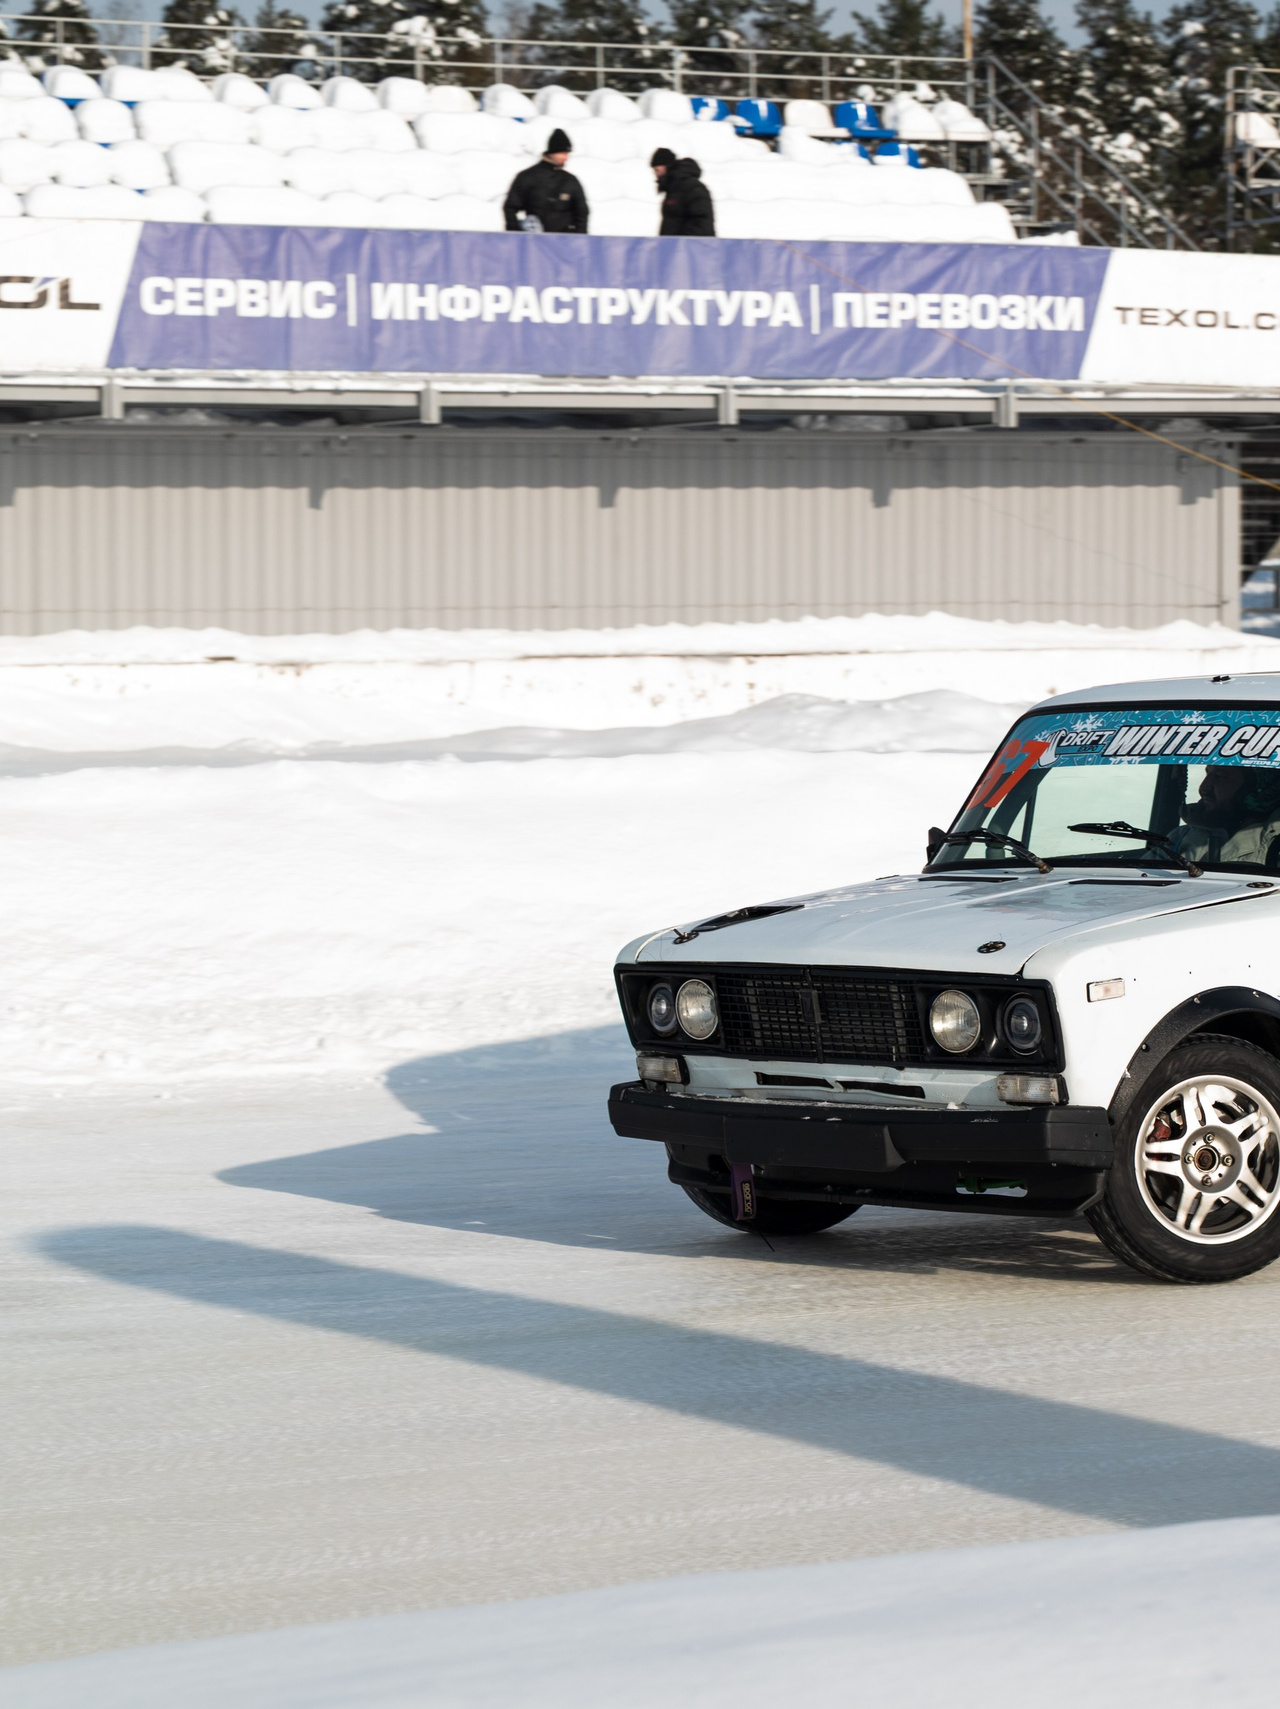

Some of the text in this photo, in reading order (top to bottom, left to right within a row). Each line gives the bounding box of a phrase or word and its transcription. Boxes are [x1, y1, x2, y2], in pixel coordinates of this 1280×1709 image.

[140, 276, 1086, 333] СЕРВИС ИНФРАСТРУКТУРА ПЕРЕВОЗКИ
[1060, 730, 1115, 746] DRIFT
[1102, 725, 1229, 757] WINTER
